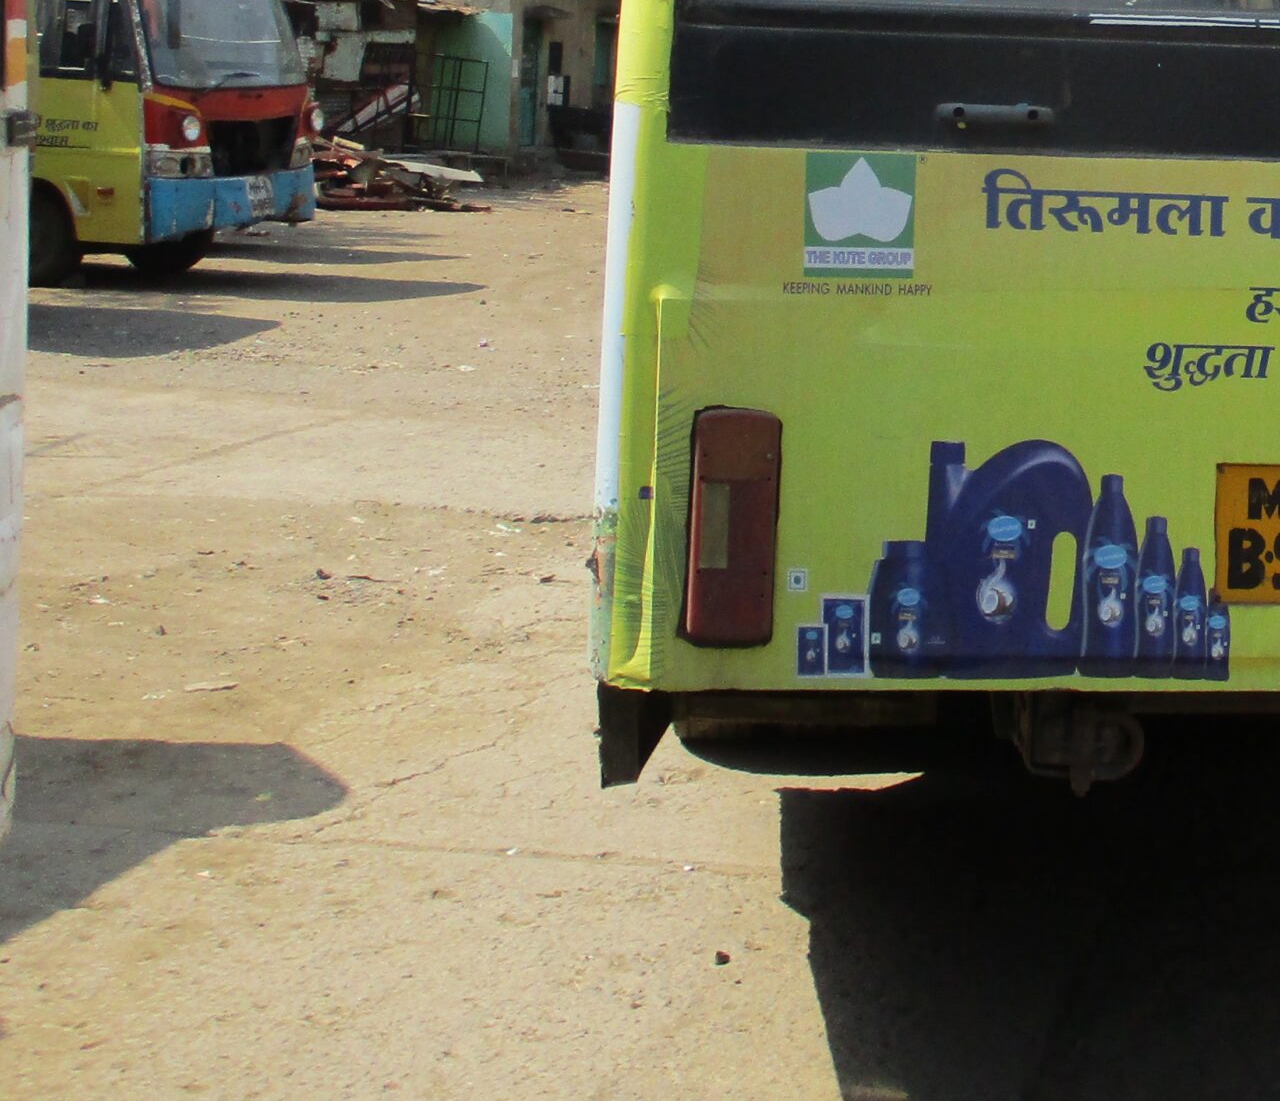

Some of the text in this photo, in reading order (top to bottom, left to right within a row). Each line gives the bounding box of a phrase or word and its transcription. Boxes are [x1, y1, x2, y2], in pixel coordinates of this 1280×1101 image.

[981, 167, 1229, 238] तिरूमला
[806, 250, 912, 266] THE KUTE GROUP
[782, 282, 933, 297] KEEPING MANKIND HAPPY
[1143, 341, 1276, 392] शुद्धता
